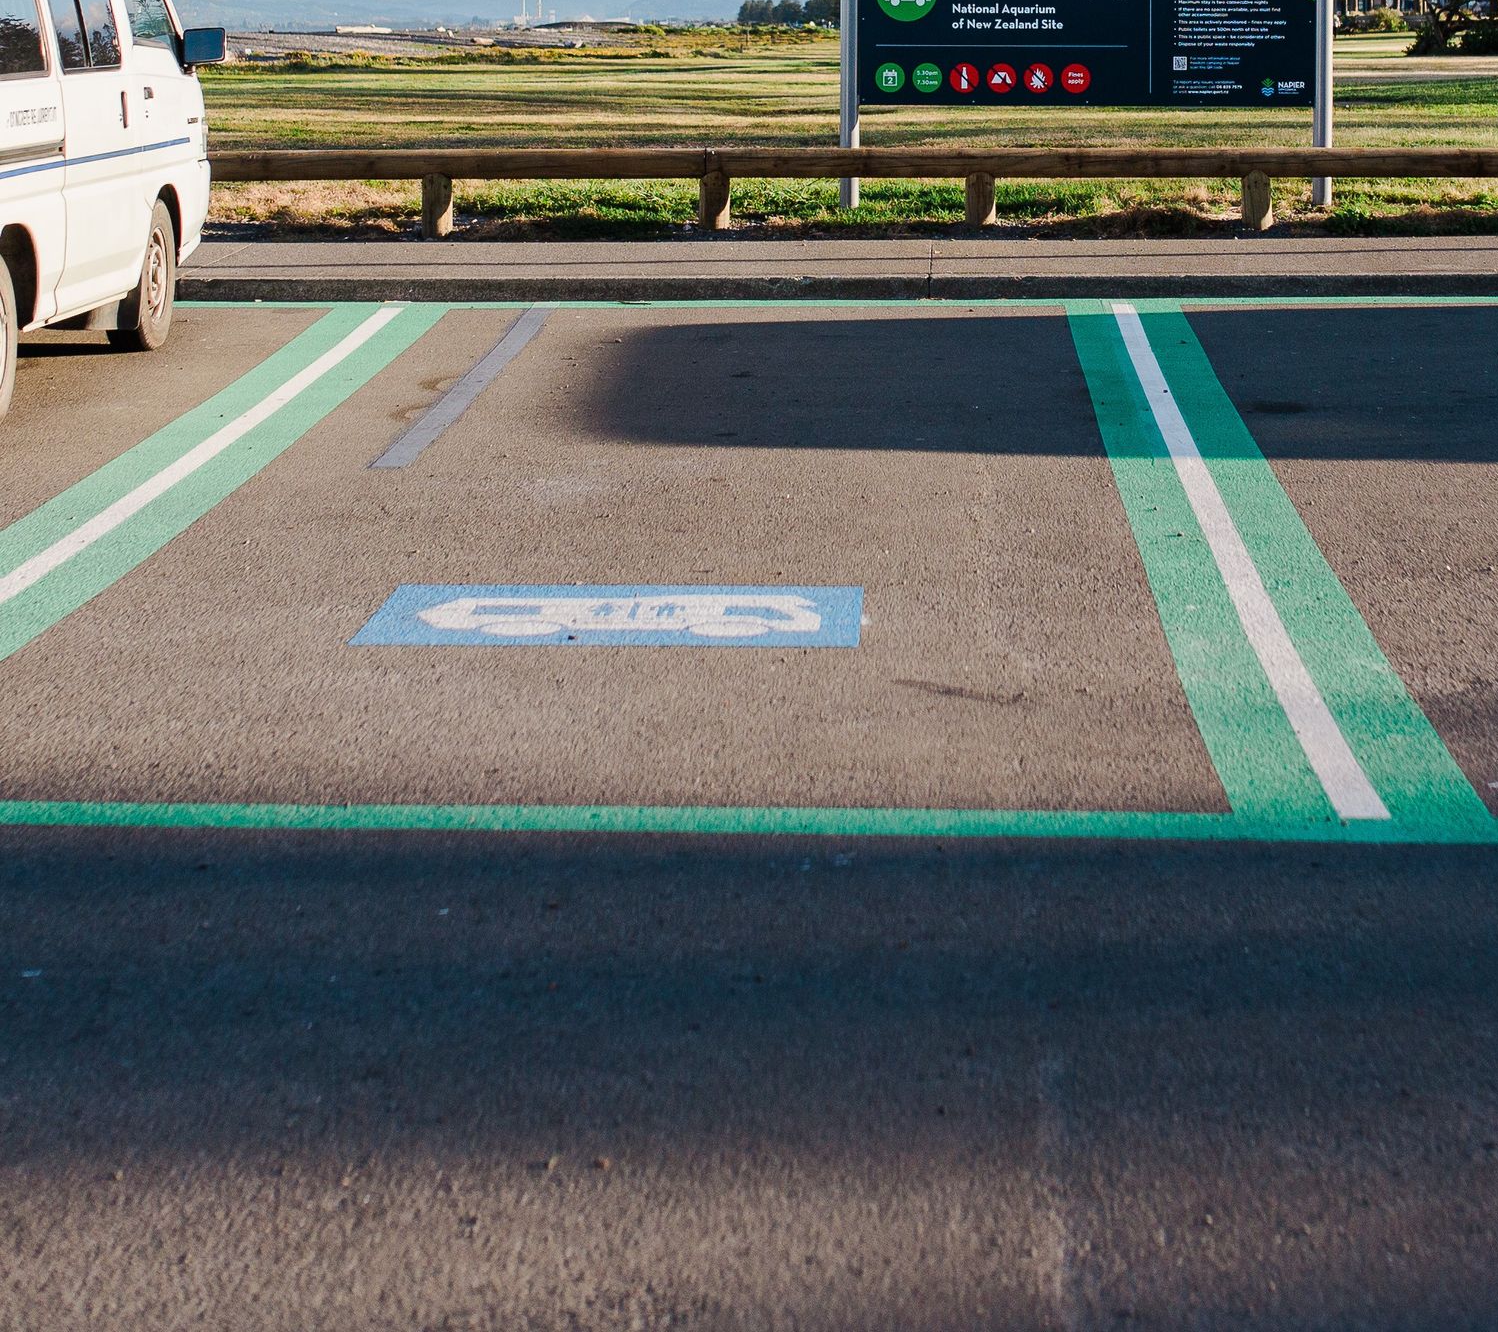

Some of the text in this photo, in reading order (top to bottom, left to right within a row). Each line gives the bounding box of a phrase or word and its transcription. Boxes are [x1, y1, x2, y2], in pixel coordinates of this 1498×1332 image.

[952, 3, 1056, 16] National Aquarium
[952, 18, 1064, 29] of New Zealand Site
